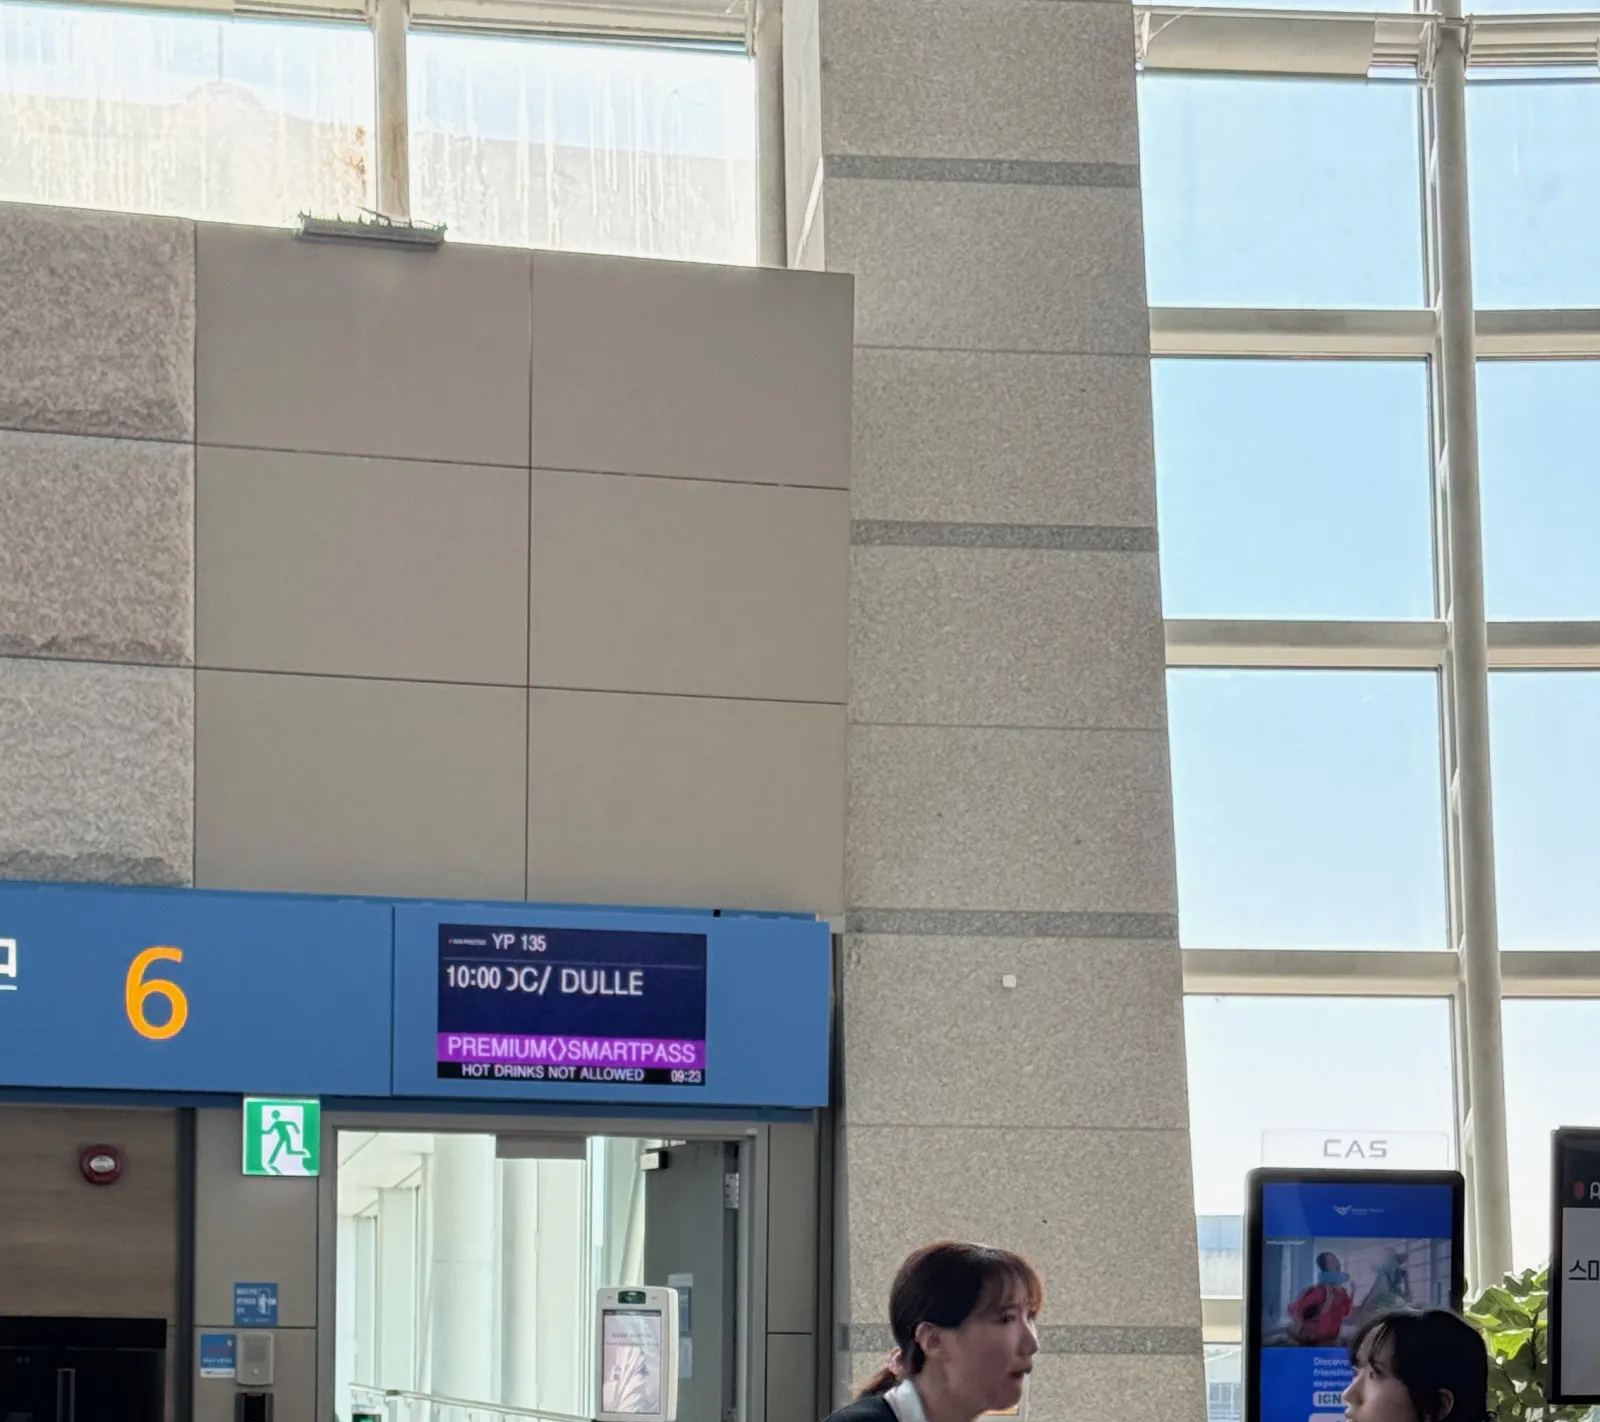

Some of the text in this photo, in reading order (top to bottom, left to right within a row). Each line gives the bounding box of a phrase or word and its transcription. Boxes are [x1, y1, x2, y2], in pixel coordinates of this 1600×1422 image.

[491, 933, 515, 950] YP
[520, 934, 547, 951] 135
[446, 964, 501, 989] 10:00
[560, 968, 644, 995] DULLE
[125, 945, 188, 1040] 6
[462, 1064, 644, 1081] HOT DRINKS NOT ALLOWED
[670, 1069, 702, 1083] 09:23
[1323, 1139, 1388, 1159] CAS
